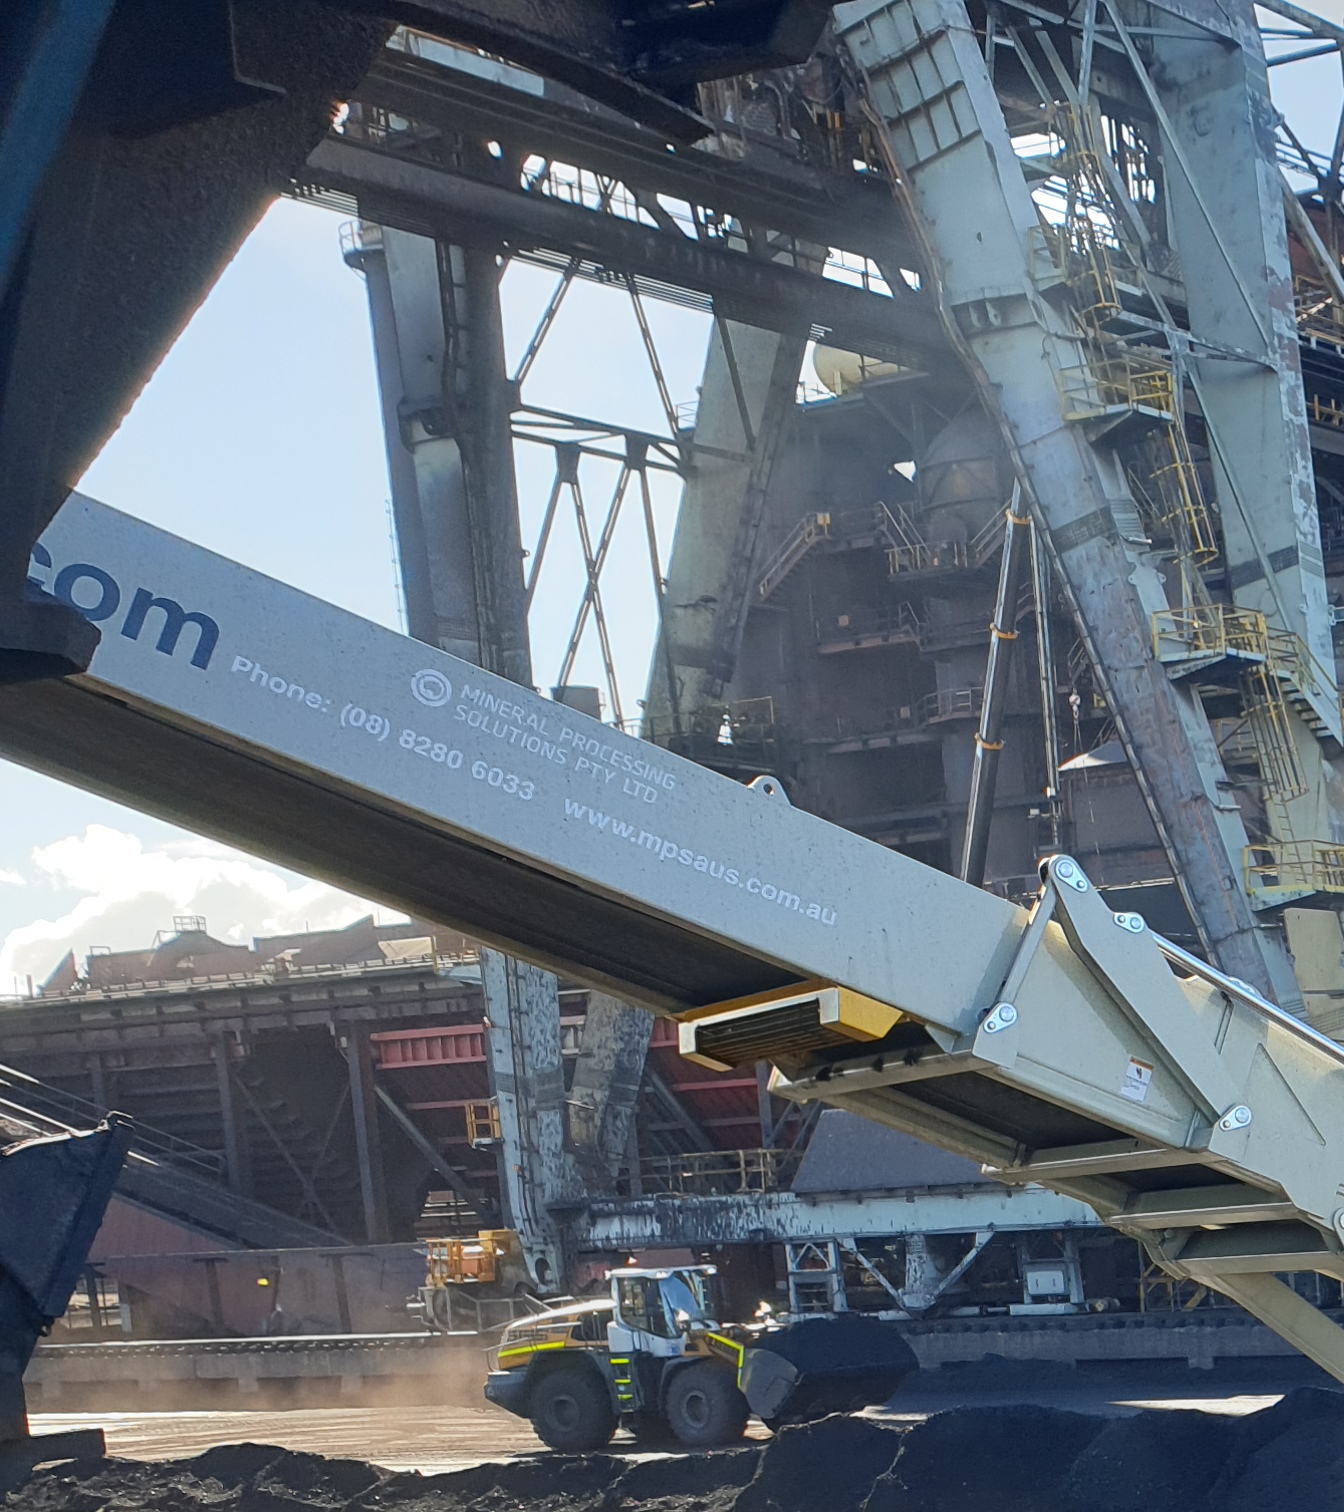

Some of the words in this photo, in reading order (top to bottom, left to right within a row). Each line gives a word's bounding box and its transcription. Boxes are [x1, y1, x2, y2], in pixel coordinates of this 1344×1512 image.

[231, 655, 333, 713] Phone:
[339, 702, 392, 742] (08)
[398, 728, 464, 770] 8280
[471, 760, 536, 802] 6033
[454, 704, 568, 766] SOLUTIONS
[574, 756, 617, 785] PTY
[622, 778, 659, 805] LTD
[460, 684, 549, 736] MINERAL
[559, 727, 677, 791] PROCESSING
[563, 797, 838, 926] www.mpsaus.com.au
